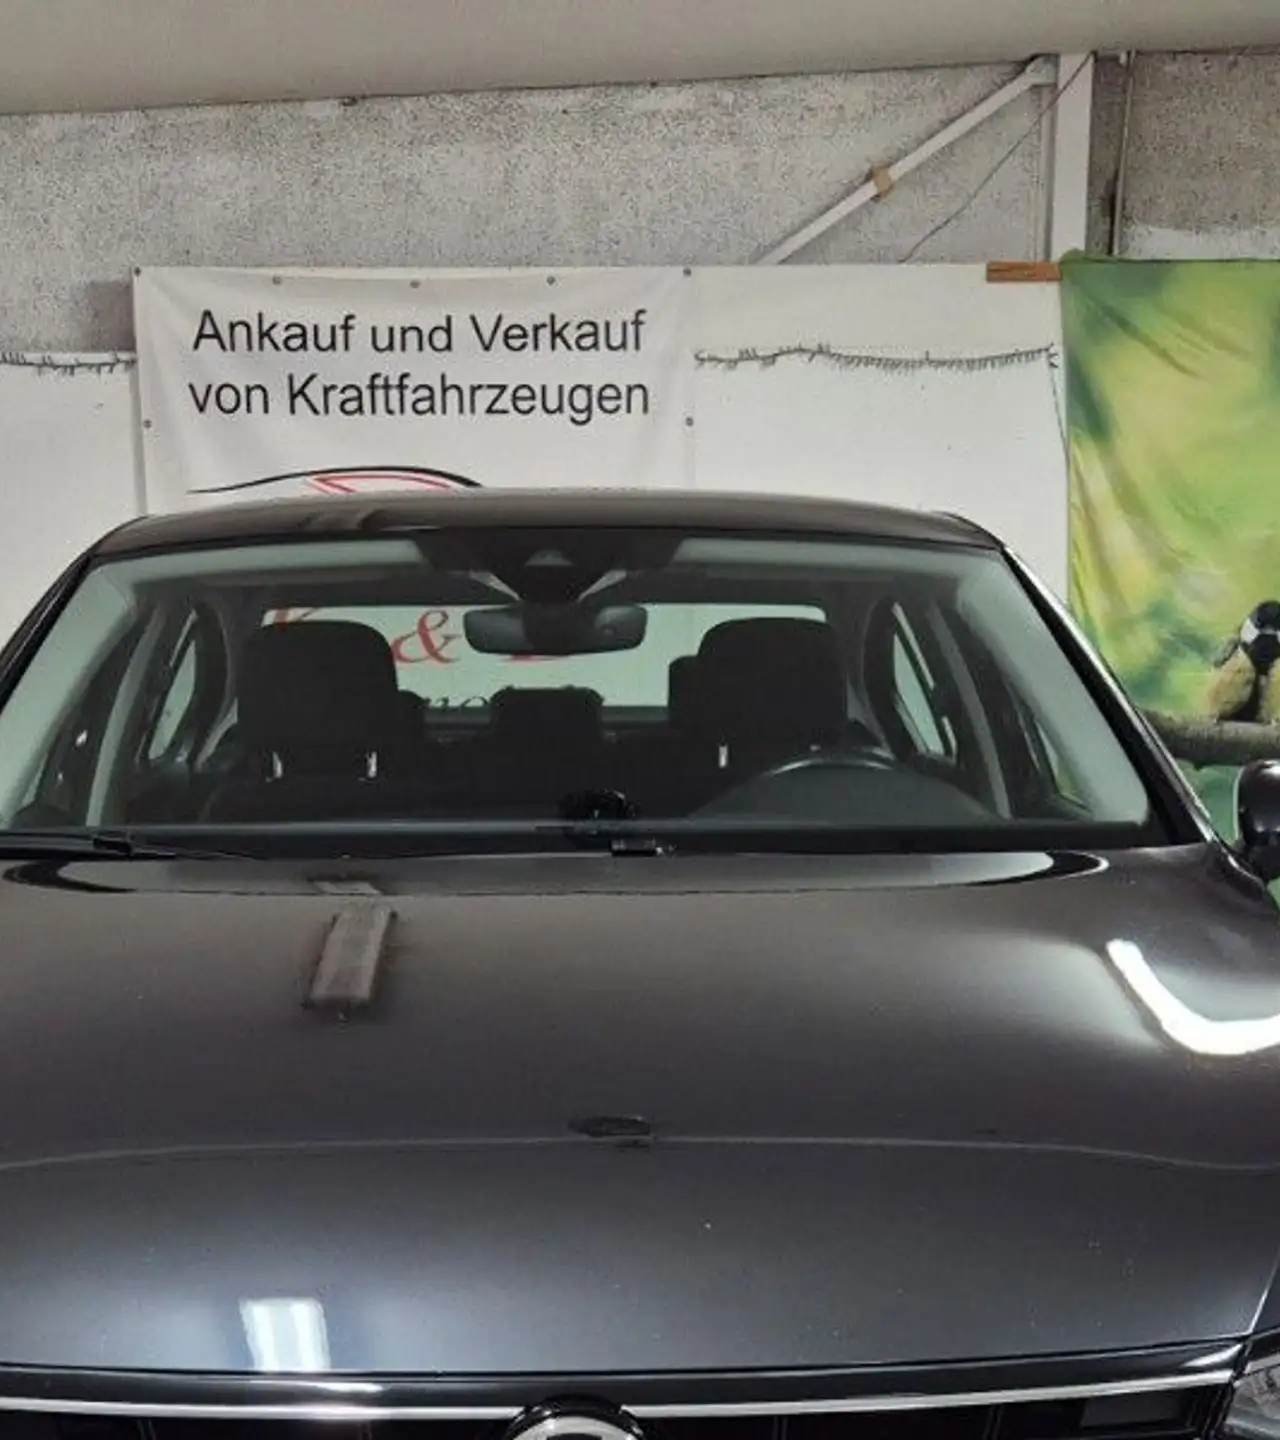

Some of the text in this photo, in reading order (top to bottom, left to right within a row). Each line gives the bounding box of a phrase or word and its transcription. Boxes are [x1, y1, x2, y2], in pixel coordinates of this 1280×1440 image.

[193, 308, 647, 352] Ankauf und Verkauf
[188, 372, 649, 426] von Kraftfahrzeugen
